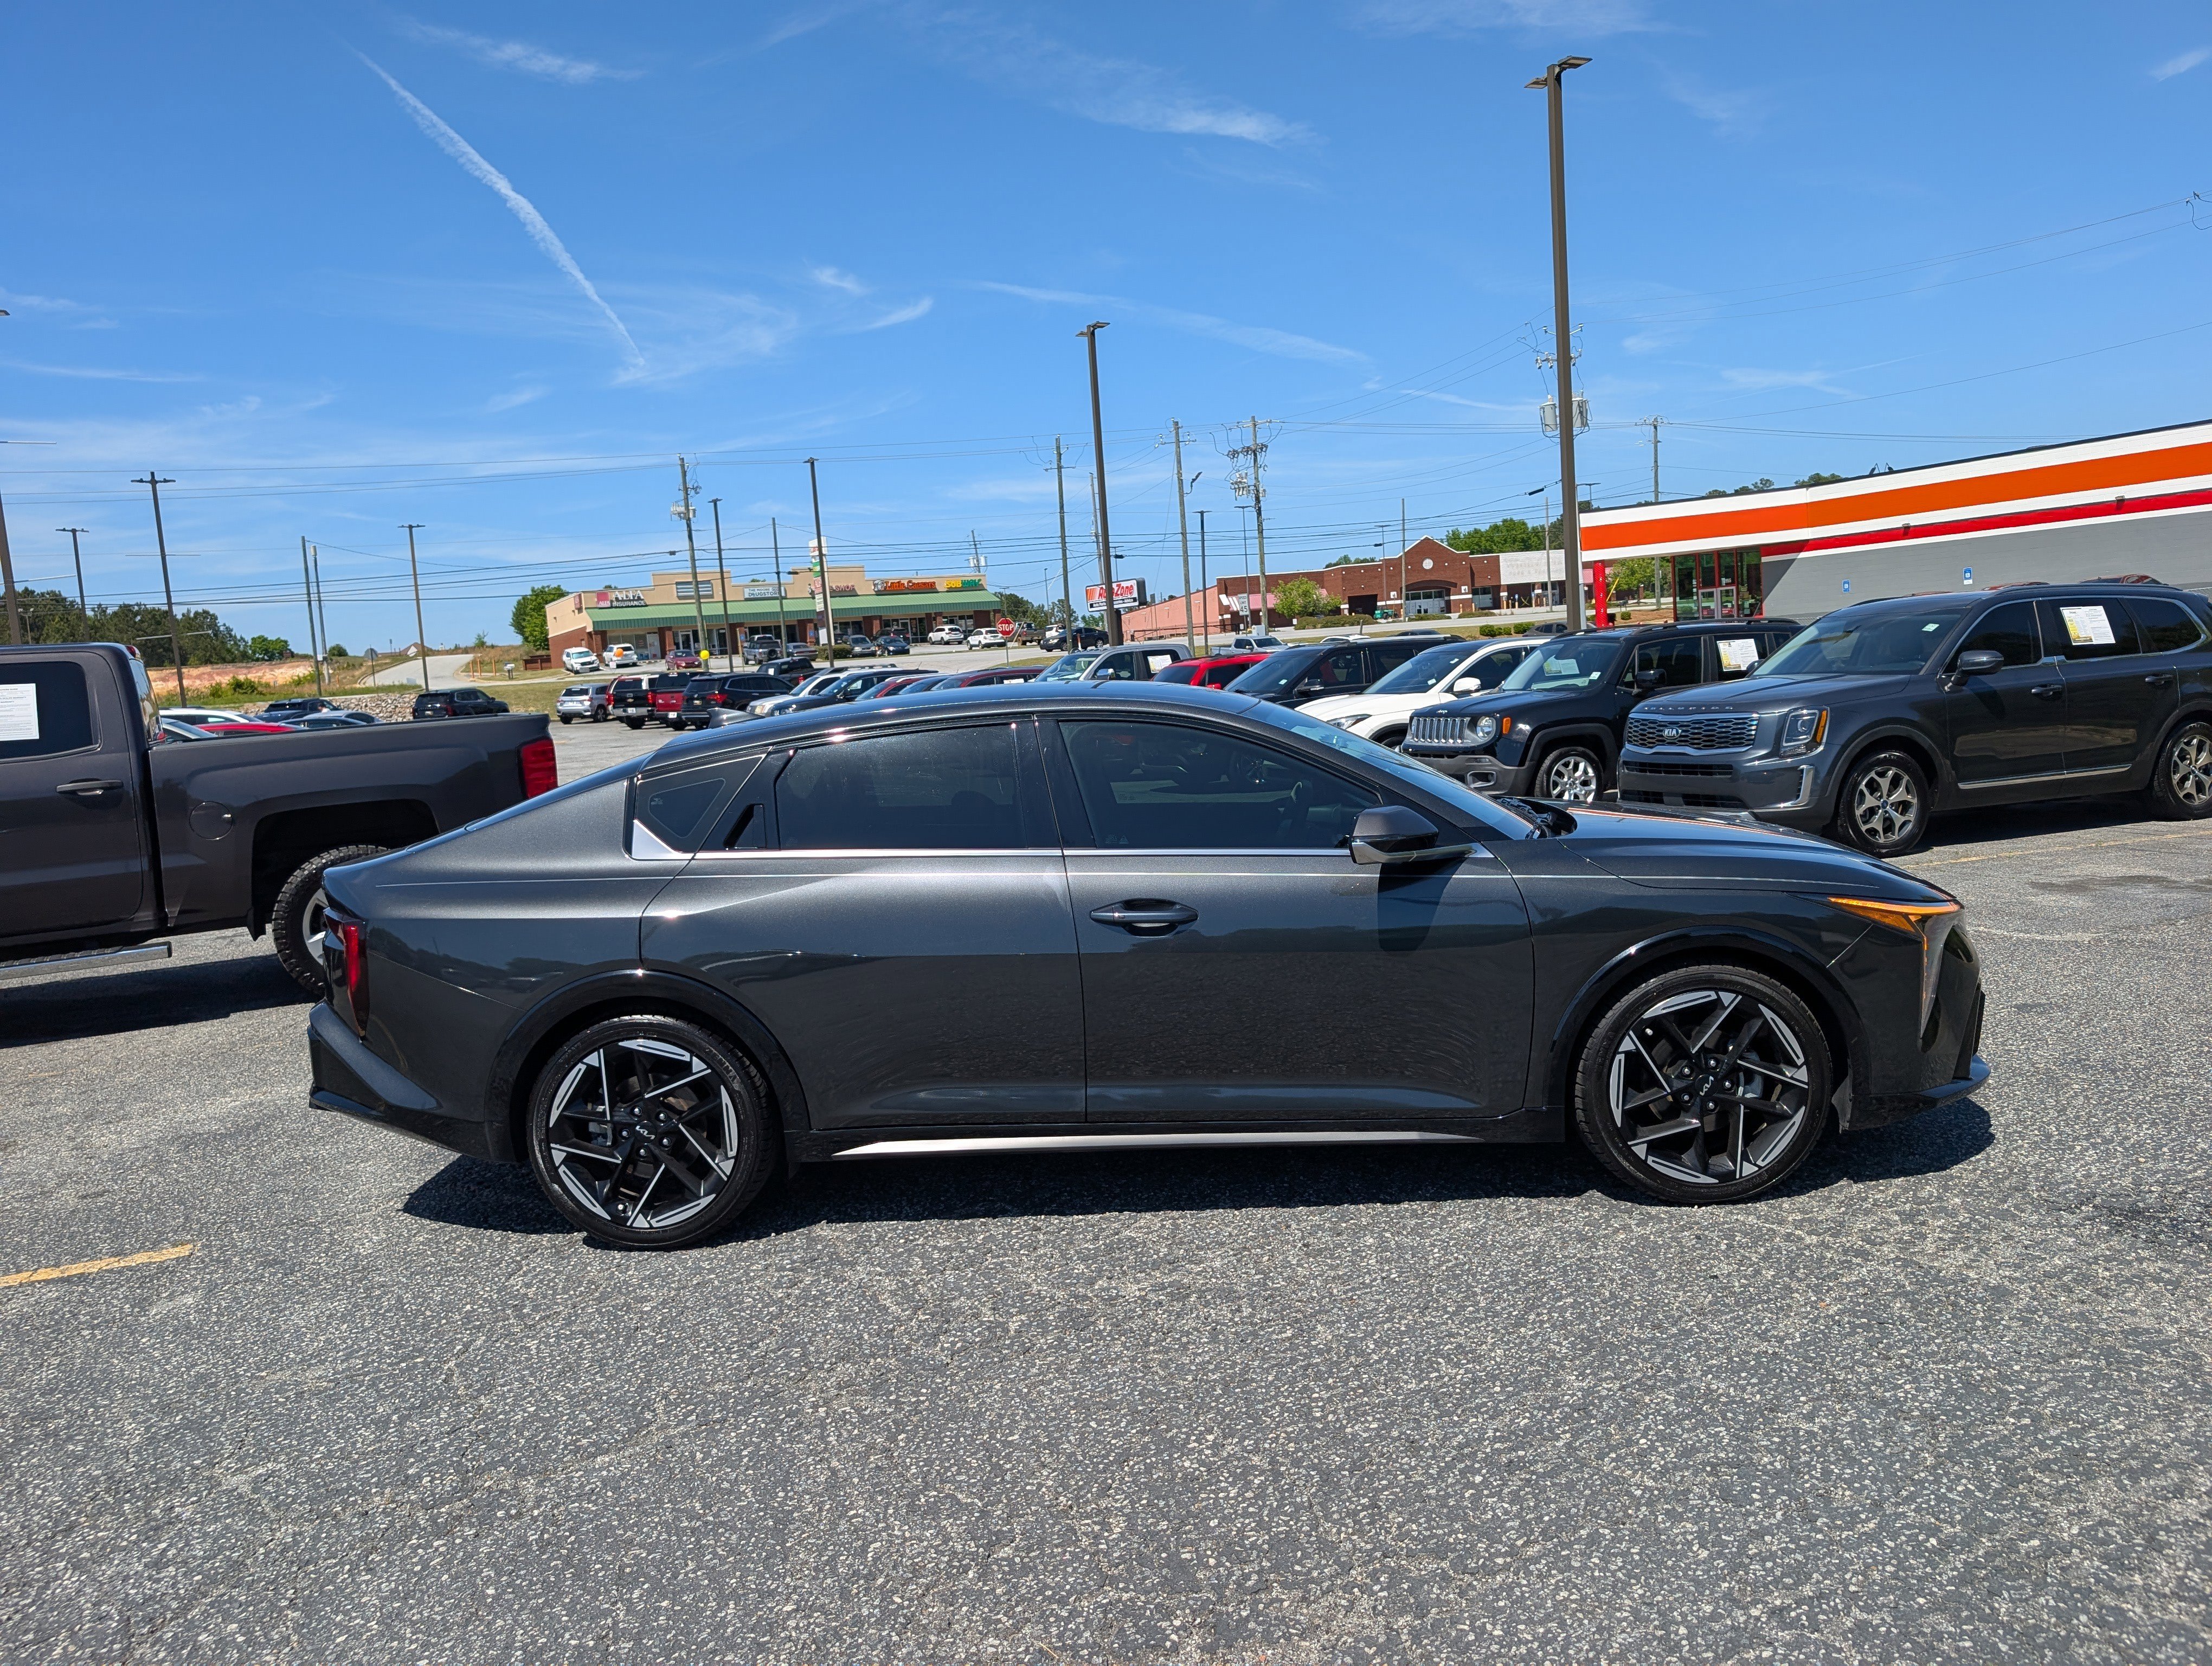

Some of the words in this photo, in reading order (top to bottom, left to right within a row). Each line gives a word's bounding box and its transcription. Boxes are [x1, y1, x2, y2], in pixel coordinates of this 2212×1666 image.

[885, 580, 906, 590] Little
[907, 580, 936, 589] Caesars
[945, 578, 982, 588] SUBWAY
[613, 590, 644, 600] ALFA
[998, 624, 1014, 632] STOP
[1664, 728, 1677, 736] KIA
